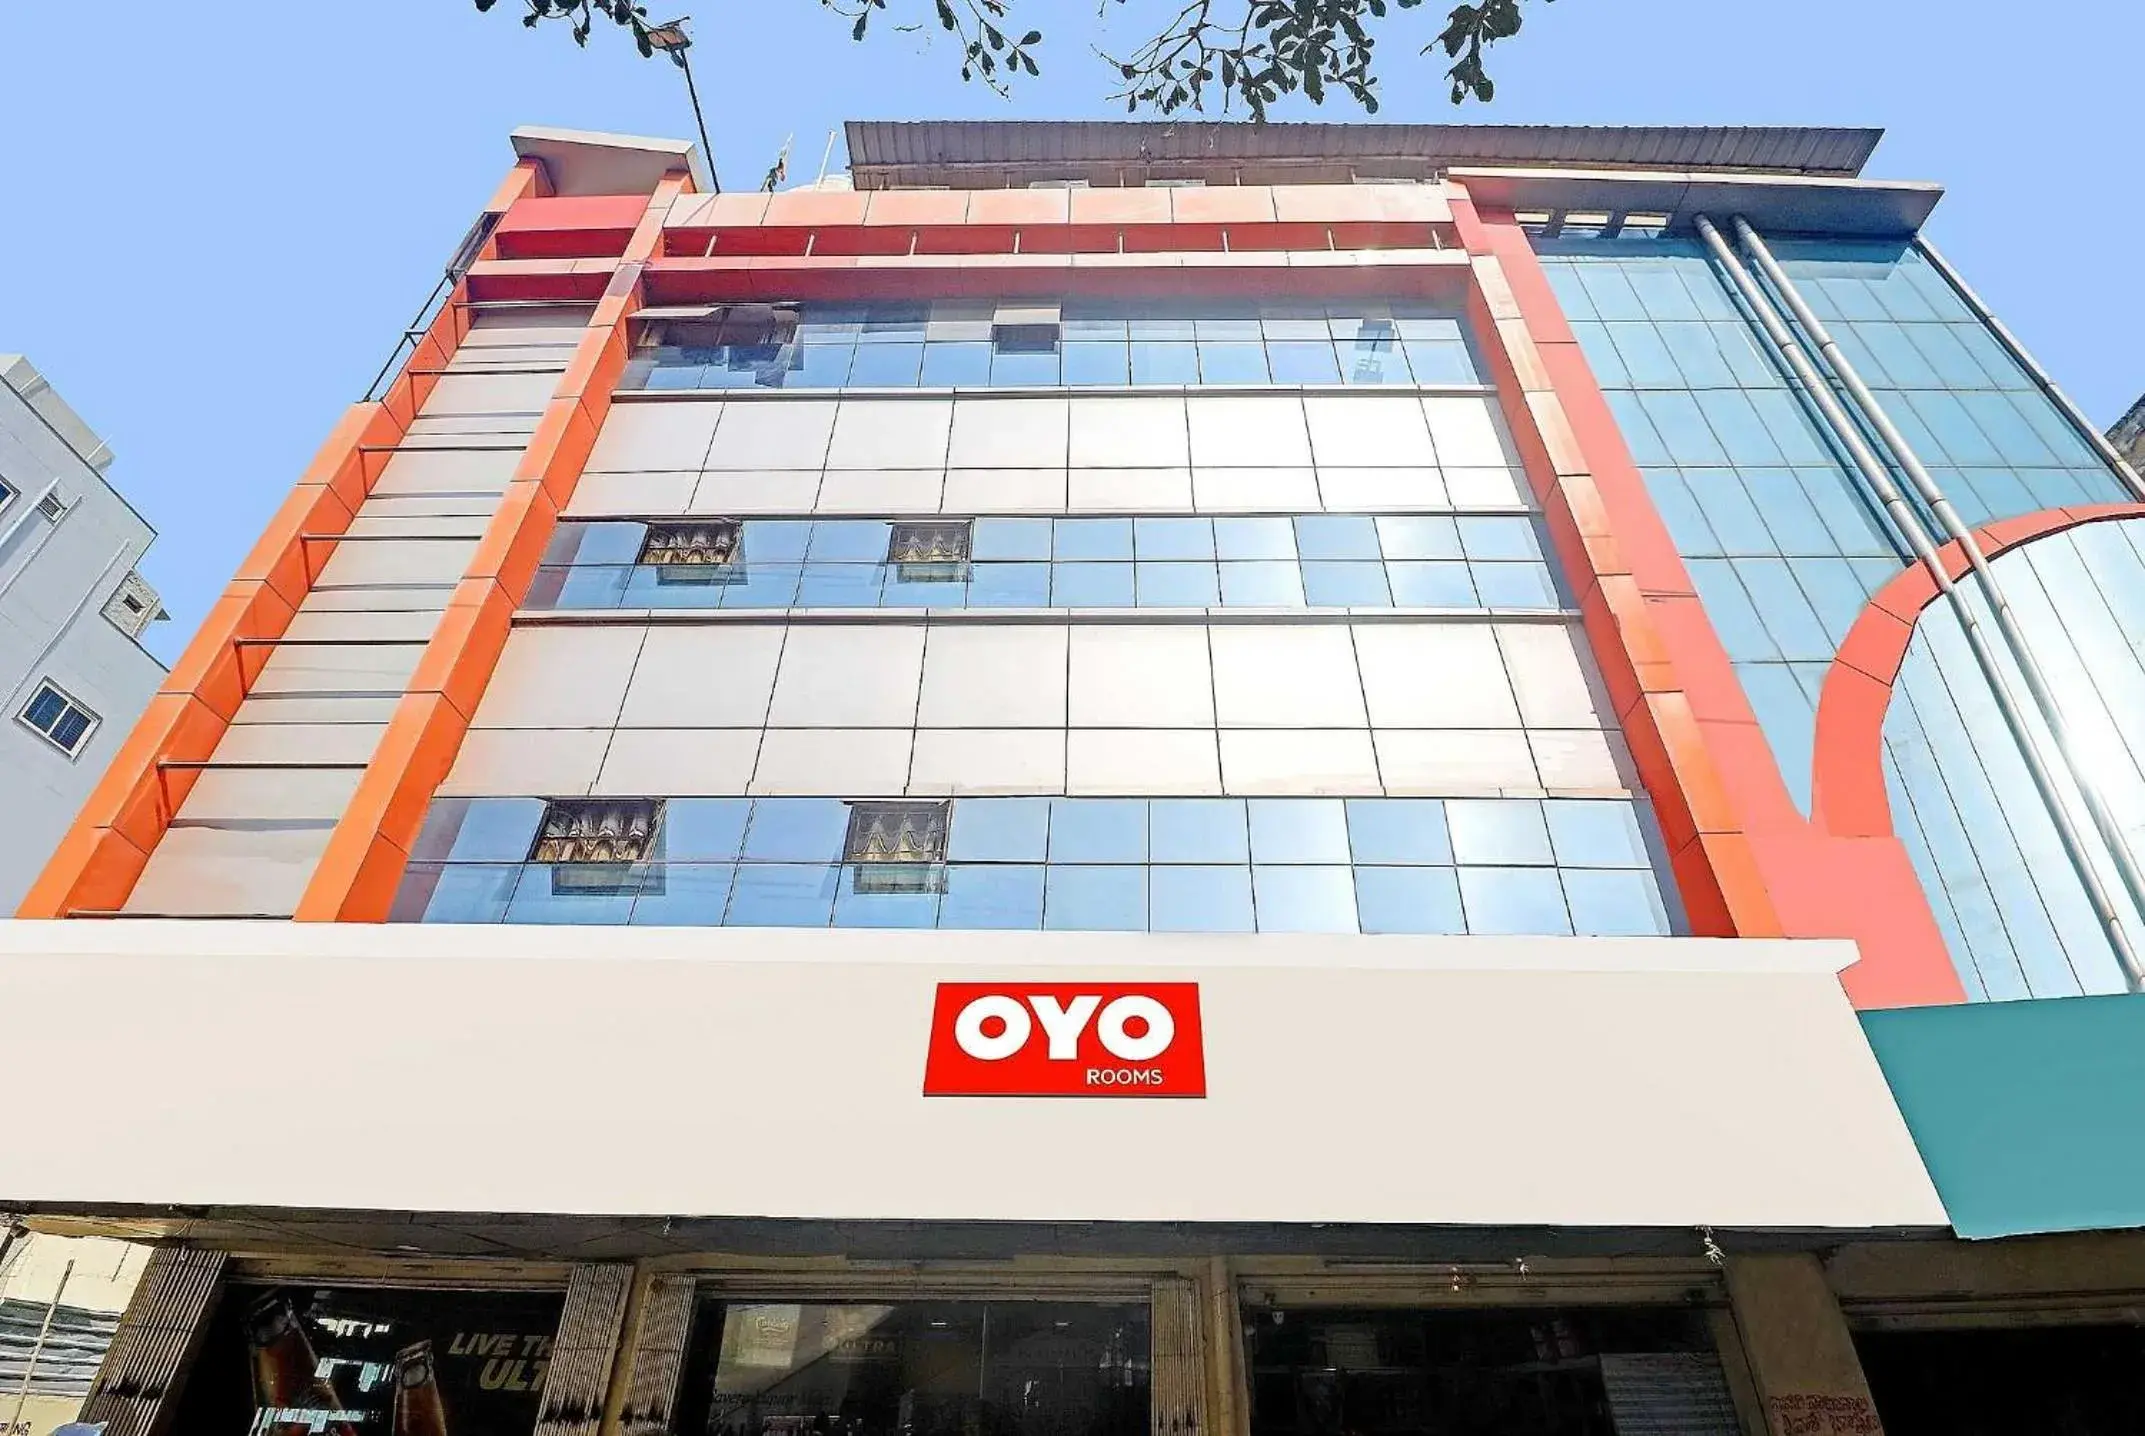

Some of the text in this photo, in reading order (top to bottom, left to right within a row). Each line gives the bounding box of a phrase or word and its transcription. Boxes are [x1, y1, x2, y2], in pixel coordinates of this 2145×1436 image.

[954, 995, 1176, 1061] OYO
[1086, 1068, 1164, 1085] ROOMS
[449, 1332, 518, 1356] LIVE
